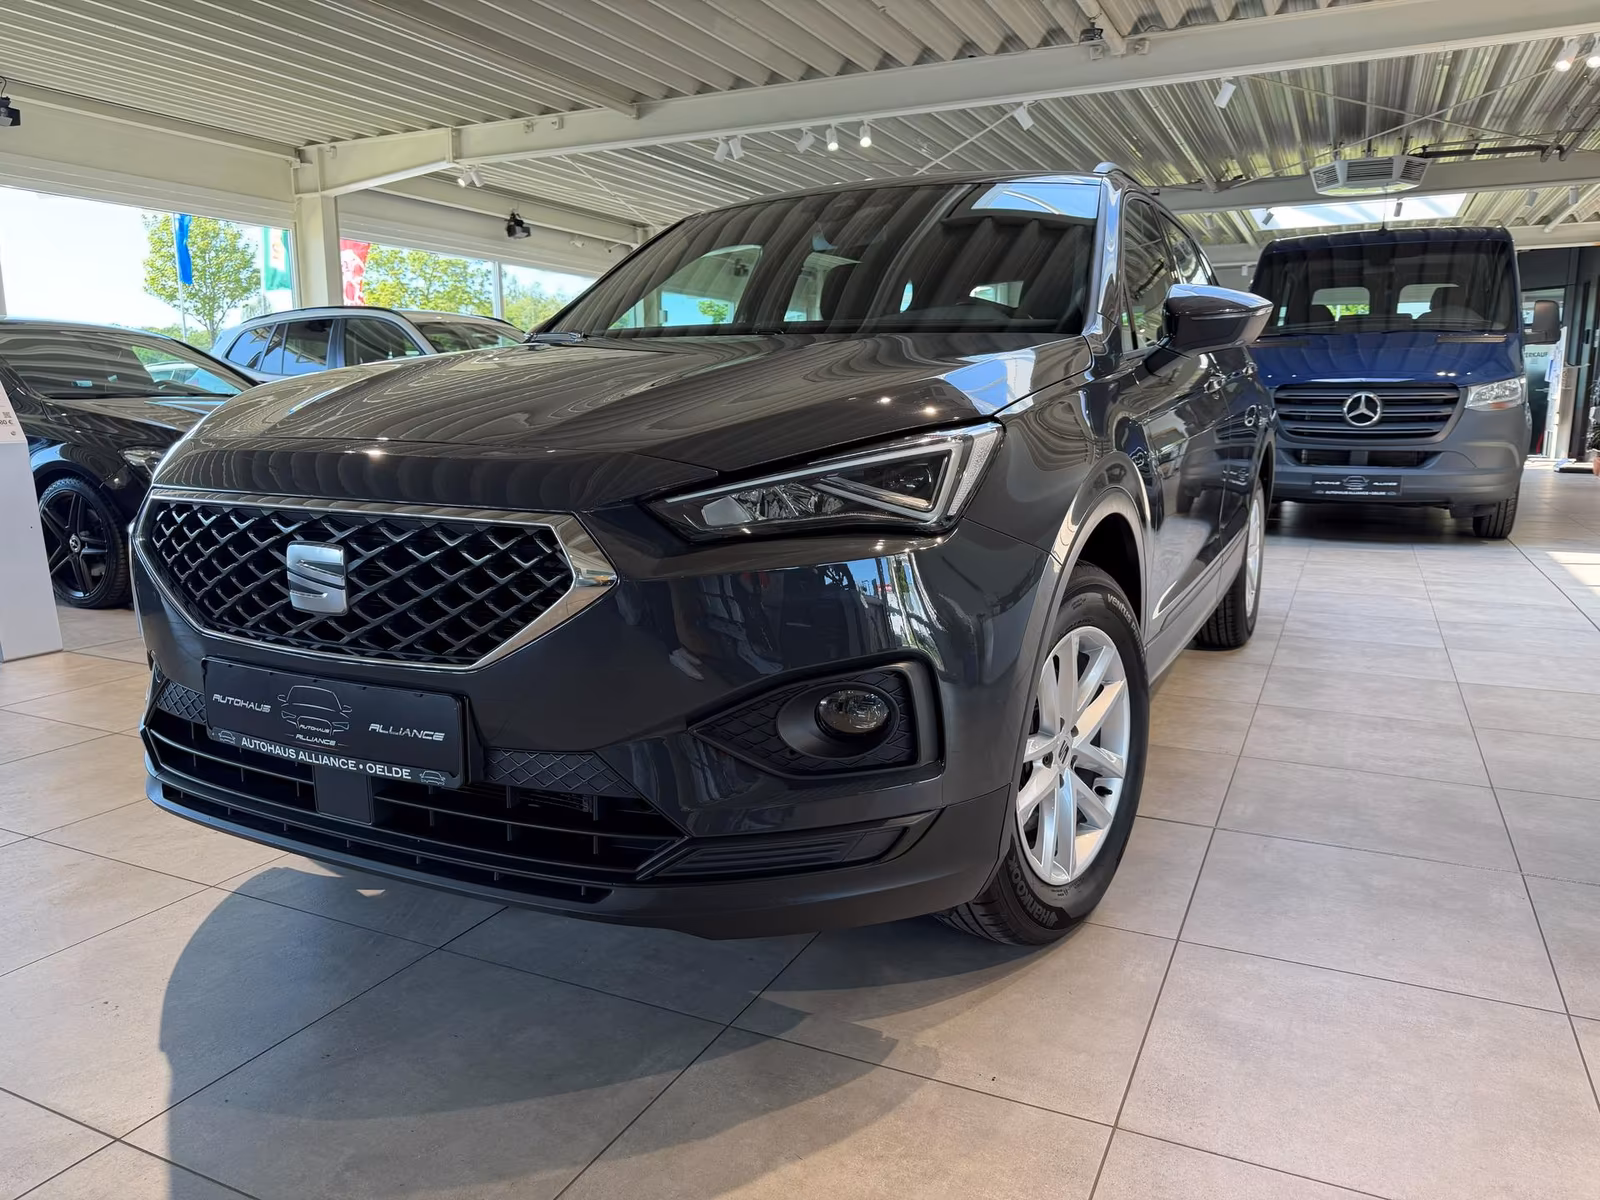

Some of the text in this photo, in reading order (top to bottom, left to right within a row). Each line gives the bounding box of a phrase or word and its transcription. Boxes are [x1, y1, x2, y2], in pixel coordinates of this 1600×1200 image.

[212, 693, 271, 713] AUTOHAUS
[299, 724, 330, 734] AUTOHAUS
[368, 723, 445, 742] ALLIANCE
[296, 733, 336, 746] ALLIANCE
[241, 737, 411, 779] AUTOHAUS ALLIANCE OELDE
